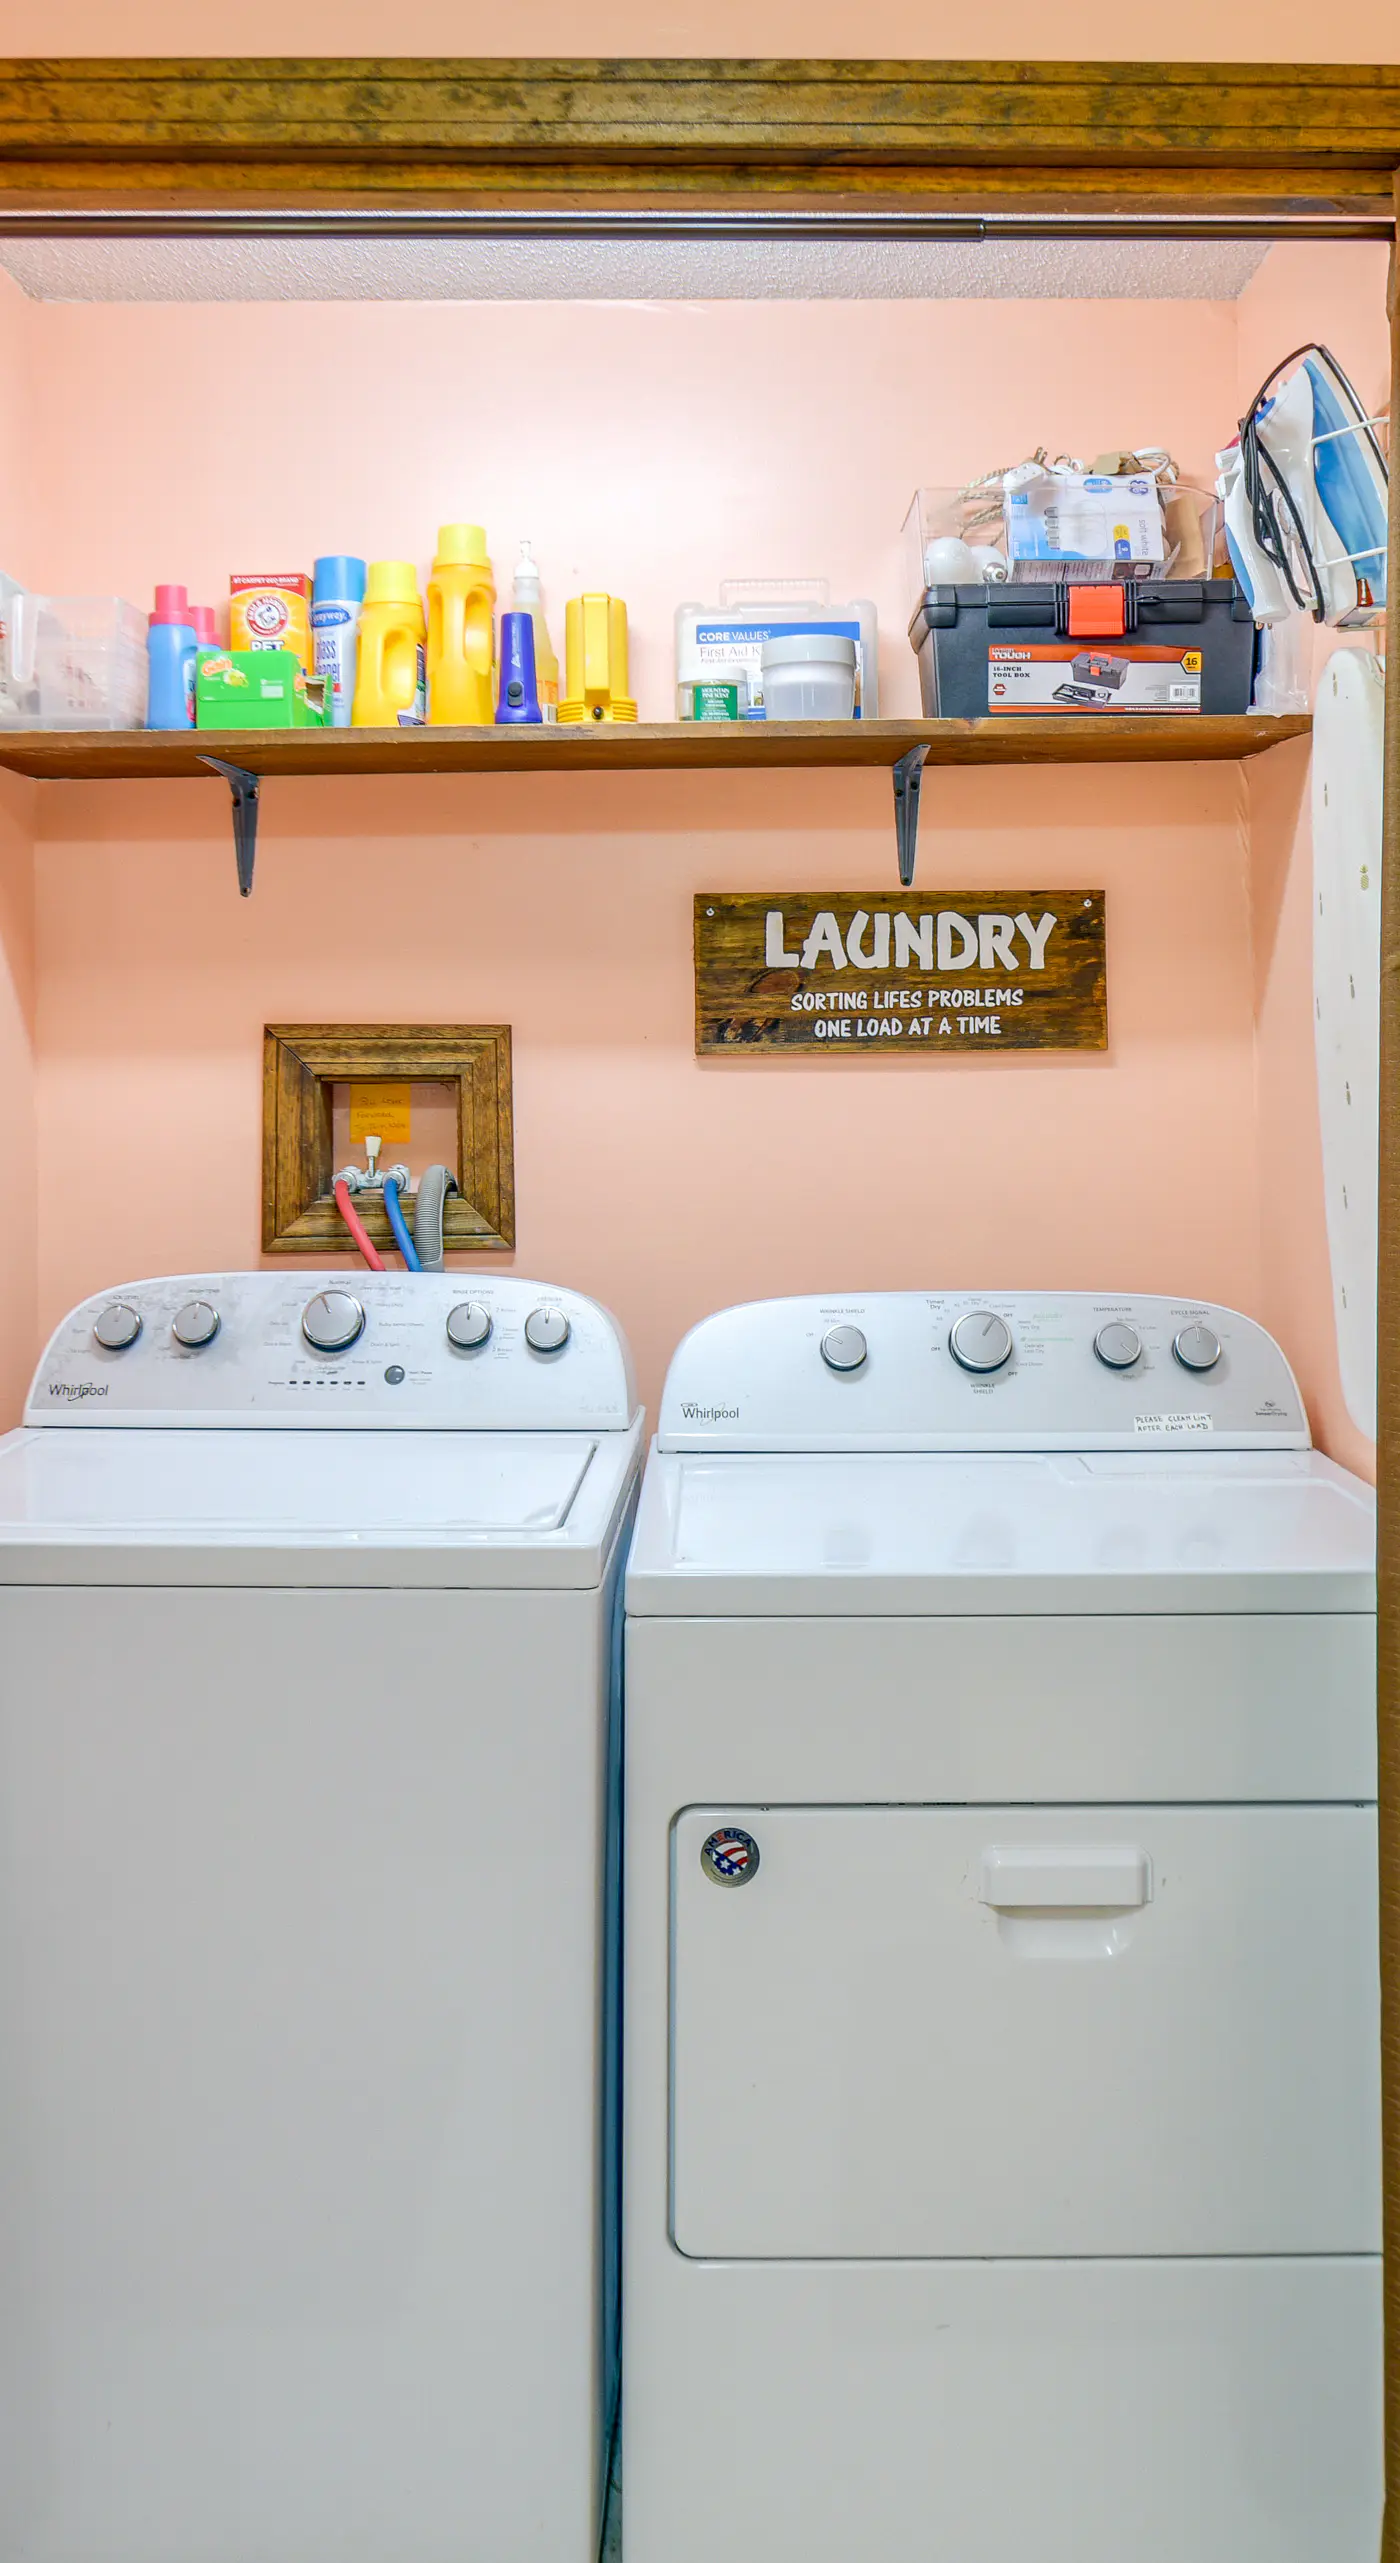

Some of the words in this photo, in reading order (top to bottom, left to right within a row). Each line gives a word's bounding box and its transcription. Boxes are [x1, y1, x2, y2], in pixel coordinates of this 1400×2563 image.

[699, 632, 730, 641] CORE
[731, 630, 769, 641] VALUES
[251, 640, 285, 653] PET
[700, 646, 725, 658] First
[728, 645, 748, 657] Aid
[992, 652, 1031, 660] TOUGH
[1186, 657, 1198, 666] 16
[765, 910, 1058, 971] LAUNDRY
[791, 992, 867, 1012] SORTING
[873, 990, 923, 1010] LIFES
[928, 988, 1024, 1008] PROBLEMS
[814, 1020, 851, 1039] ONE
[856, 1019, 903, 1037] LOAD
[908, 1018, 933, 1035] AT
[938, 1018, 953, 1035] A
[956, 1016, 1002, 1035] TIME
[49, 1384, 109, 1400] Whirlpool
[682, 1407, 740, 1422] Whirlpool
[1137, 1424, 1162, 1432] AFTER
[704, 1830, 752, 1857] AMERICA
